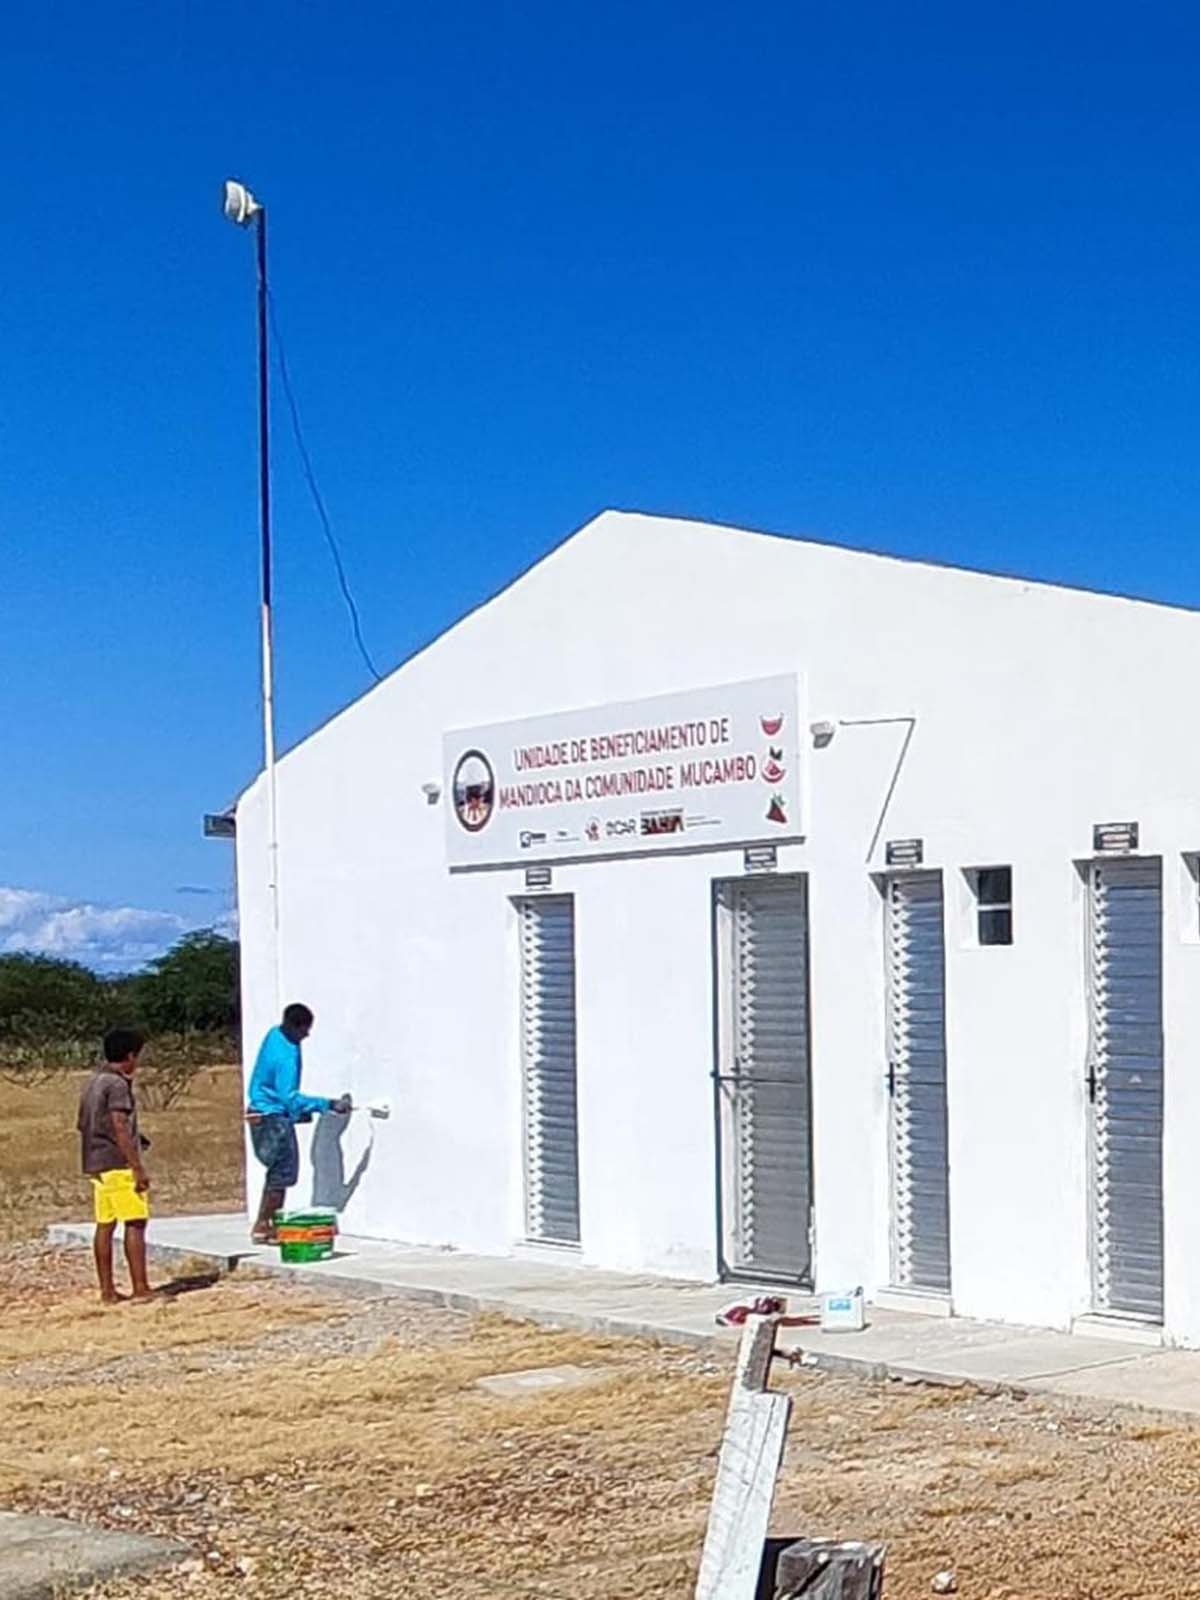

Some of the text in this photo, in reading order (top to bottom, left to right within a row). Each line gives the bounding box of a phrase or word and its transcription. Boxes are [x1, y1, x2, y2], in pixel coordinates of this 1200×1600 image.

[513, 718, 729, 772] UNIDADE DE BENEFICIAMENTO DE
[499, 756, 756, 809] MANDIOCA DA COMUNIDADE MUCAMBO
